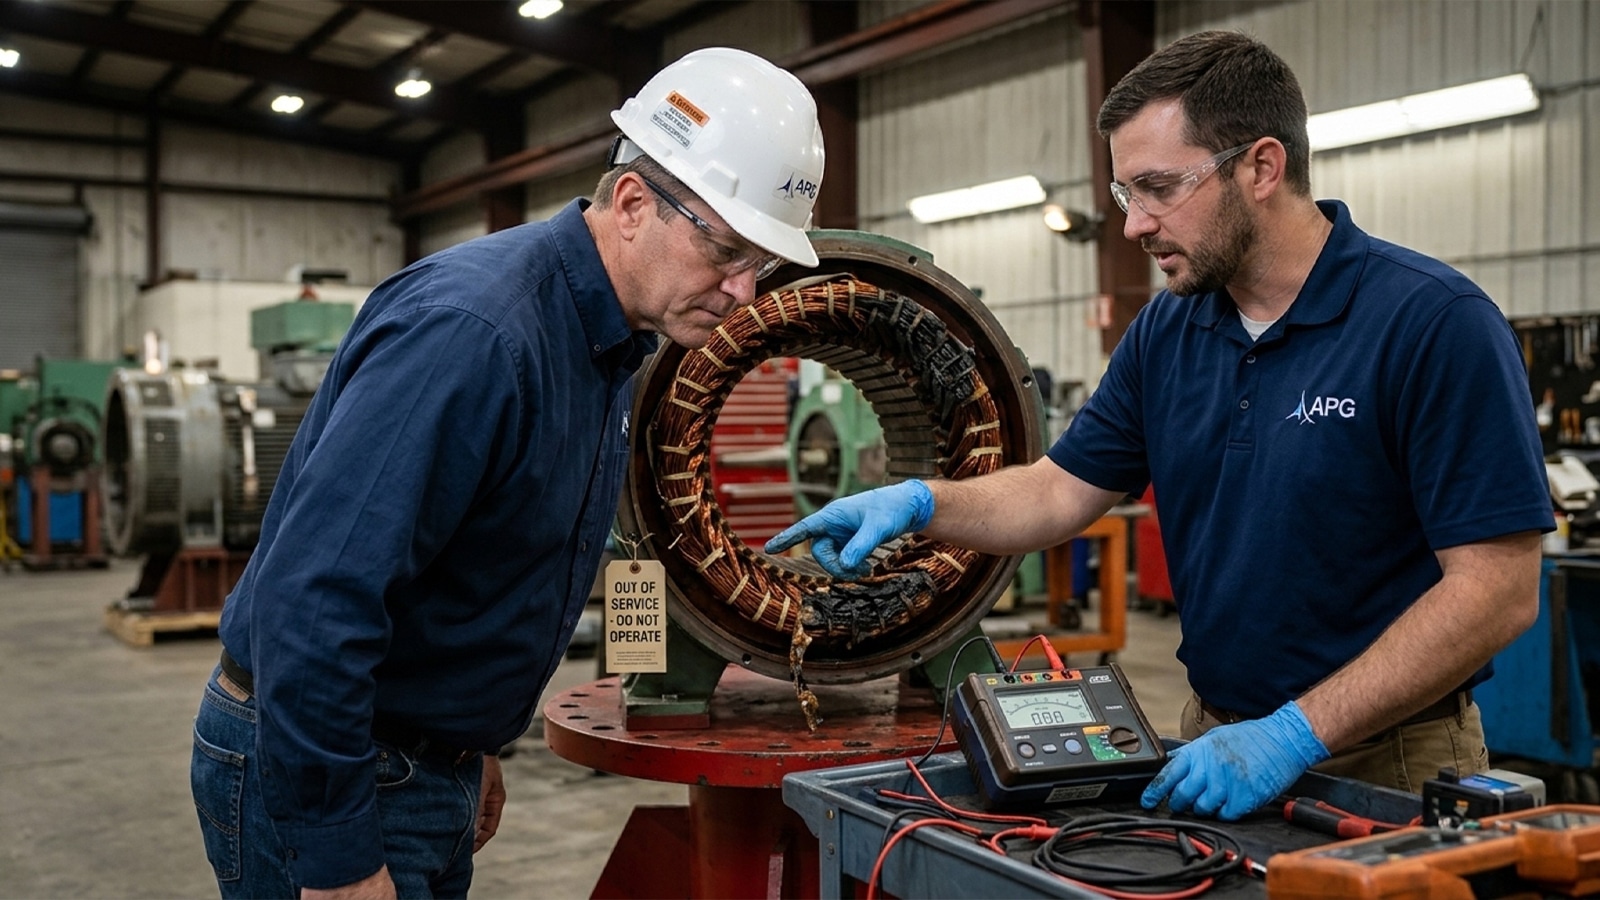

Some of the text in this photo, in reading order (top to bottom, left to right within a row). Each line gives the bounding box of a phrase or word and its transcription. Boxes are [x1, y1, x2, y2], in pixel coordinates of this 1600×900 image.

[795, 179, 817, 199] APG
[1309, 396, 1356, 418] APG
[614, 581, 656, 594] OUT OF
[611, 597, 660, 610] SERVICE
[636, 614, 660, 626] NOT
[610, 630, 662, 643] OPERATE
